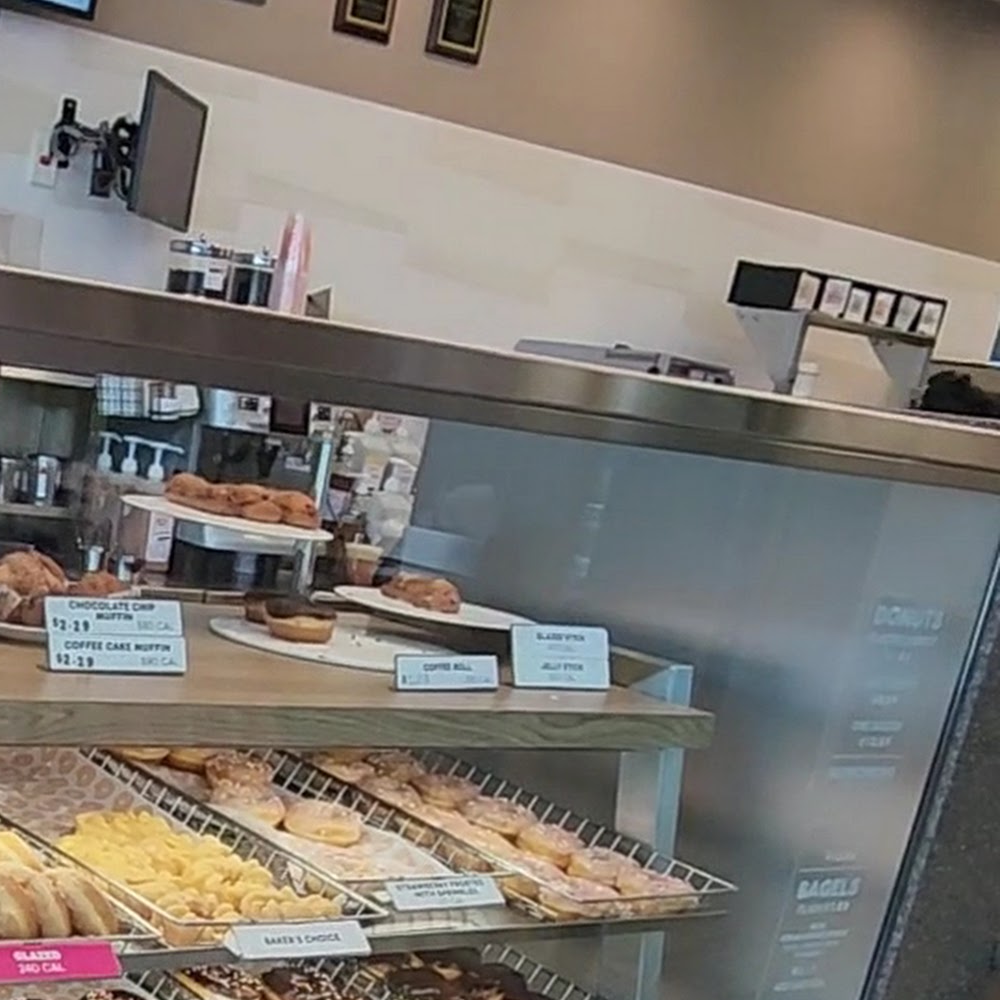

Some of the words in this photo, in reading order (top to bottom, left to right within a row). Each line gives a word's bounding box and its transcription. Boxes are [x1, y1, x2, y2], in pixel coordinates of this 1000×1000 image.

[68, 600, 130, 612] CHOCOLATE
[132, 602, 156, 612] CHIP
[96, 612, 134, 621] MUFFIN
[64, 640, 103, 651] COFFEE
[105, 641, 131, 652] CAKE
[134, 643, 171, 653] MUFFIN
[264, 935, 303, 946] BAKER'S
[305, 932, 341, 943] CHOICE
[12, 950, 62, 961] GLAZED
[42, 961, 67, 973] CAL
